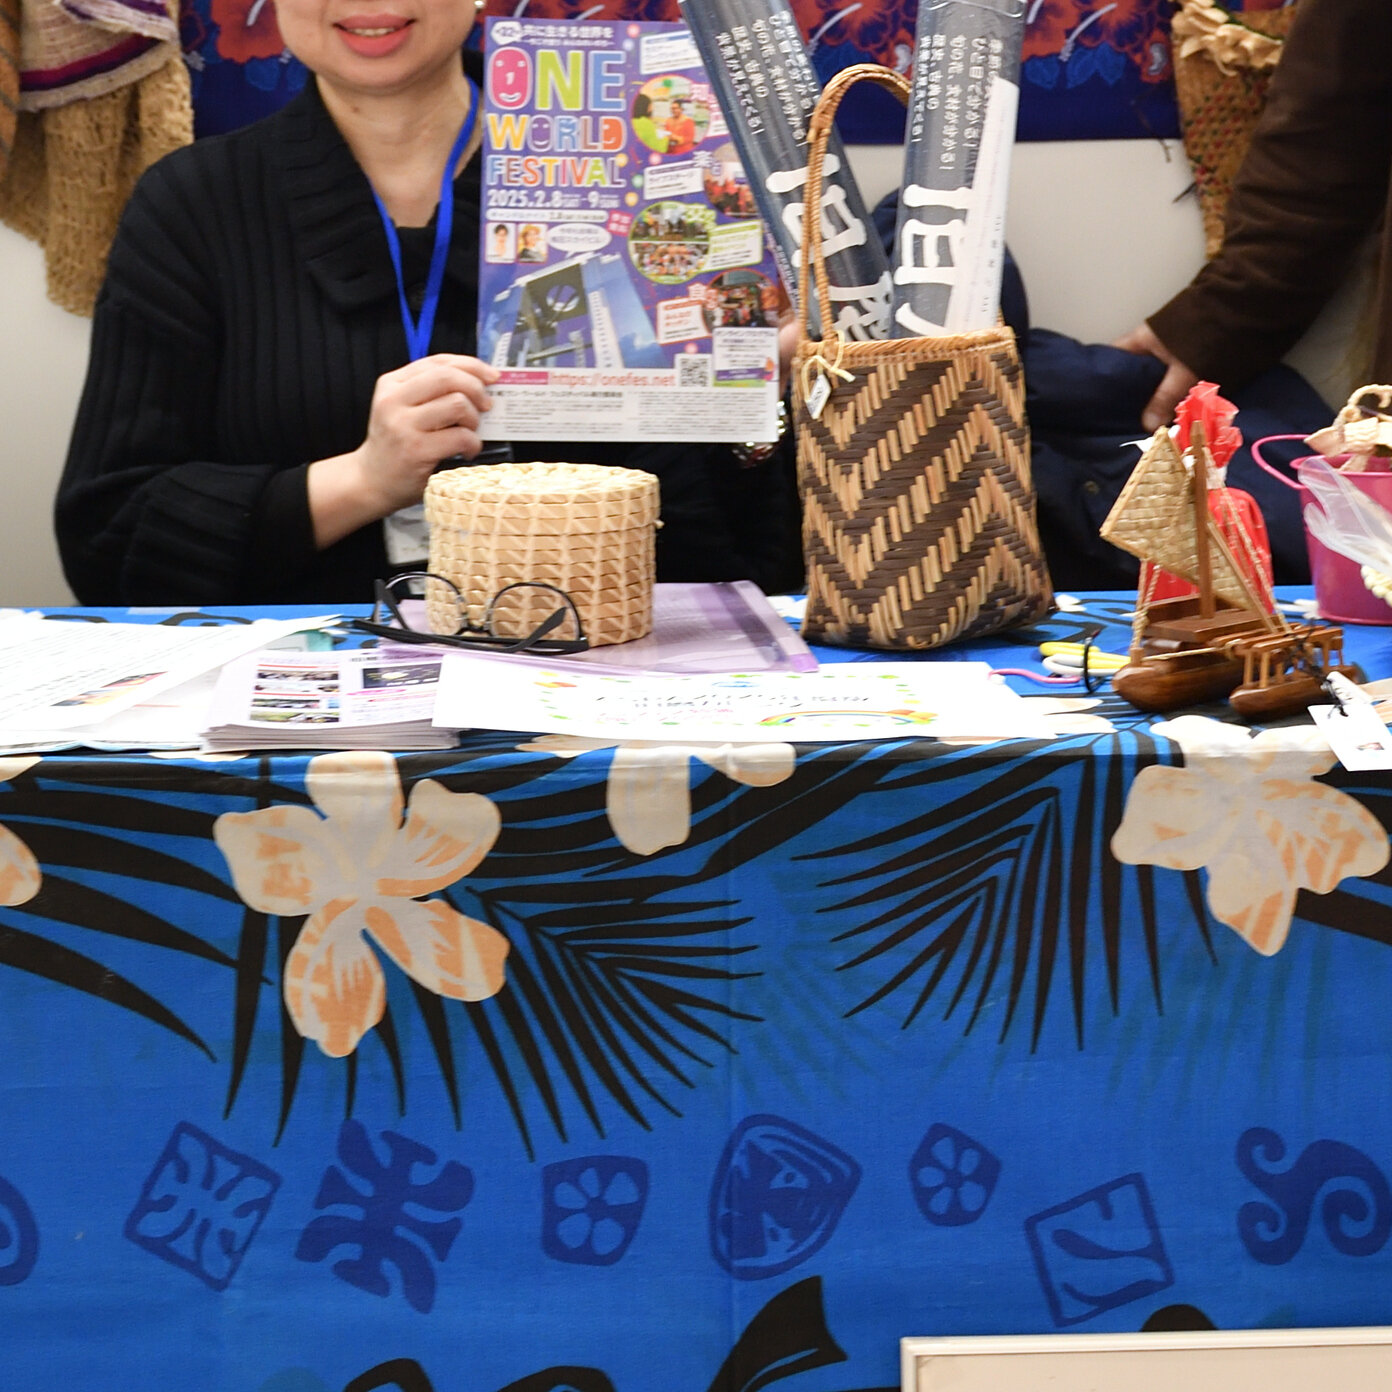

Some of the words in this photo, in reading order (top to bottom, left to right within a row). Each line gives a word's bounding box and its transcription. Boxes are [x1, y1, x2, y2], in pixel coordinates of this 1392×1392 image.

[486, 46, 627, 112] ONE
[486, 113, 627, 153] WORLD
[486, 155, 627, 188] FESTIVAL
